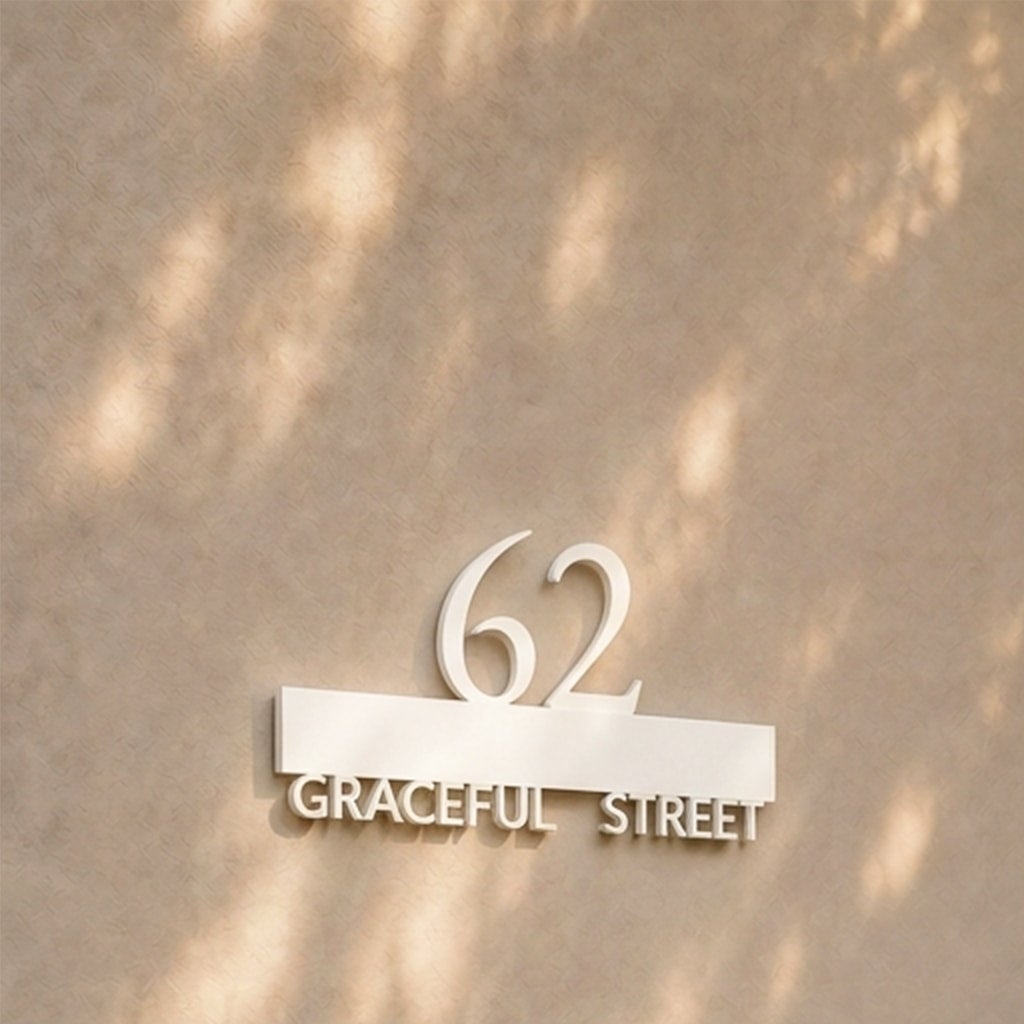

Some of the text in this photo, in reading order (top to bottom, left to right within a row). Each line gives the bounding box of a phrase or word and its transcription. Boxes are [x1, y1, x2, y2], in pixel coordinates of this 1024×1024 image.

[436, 529, 642, 714] 62
[288, 774, 765, 841] GRACEFUL STREET
